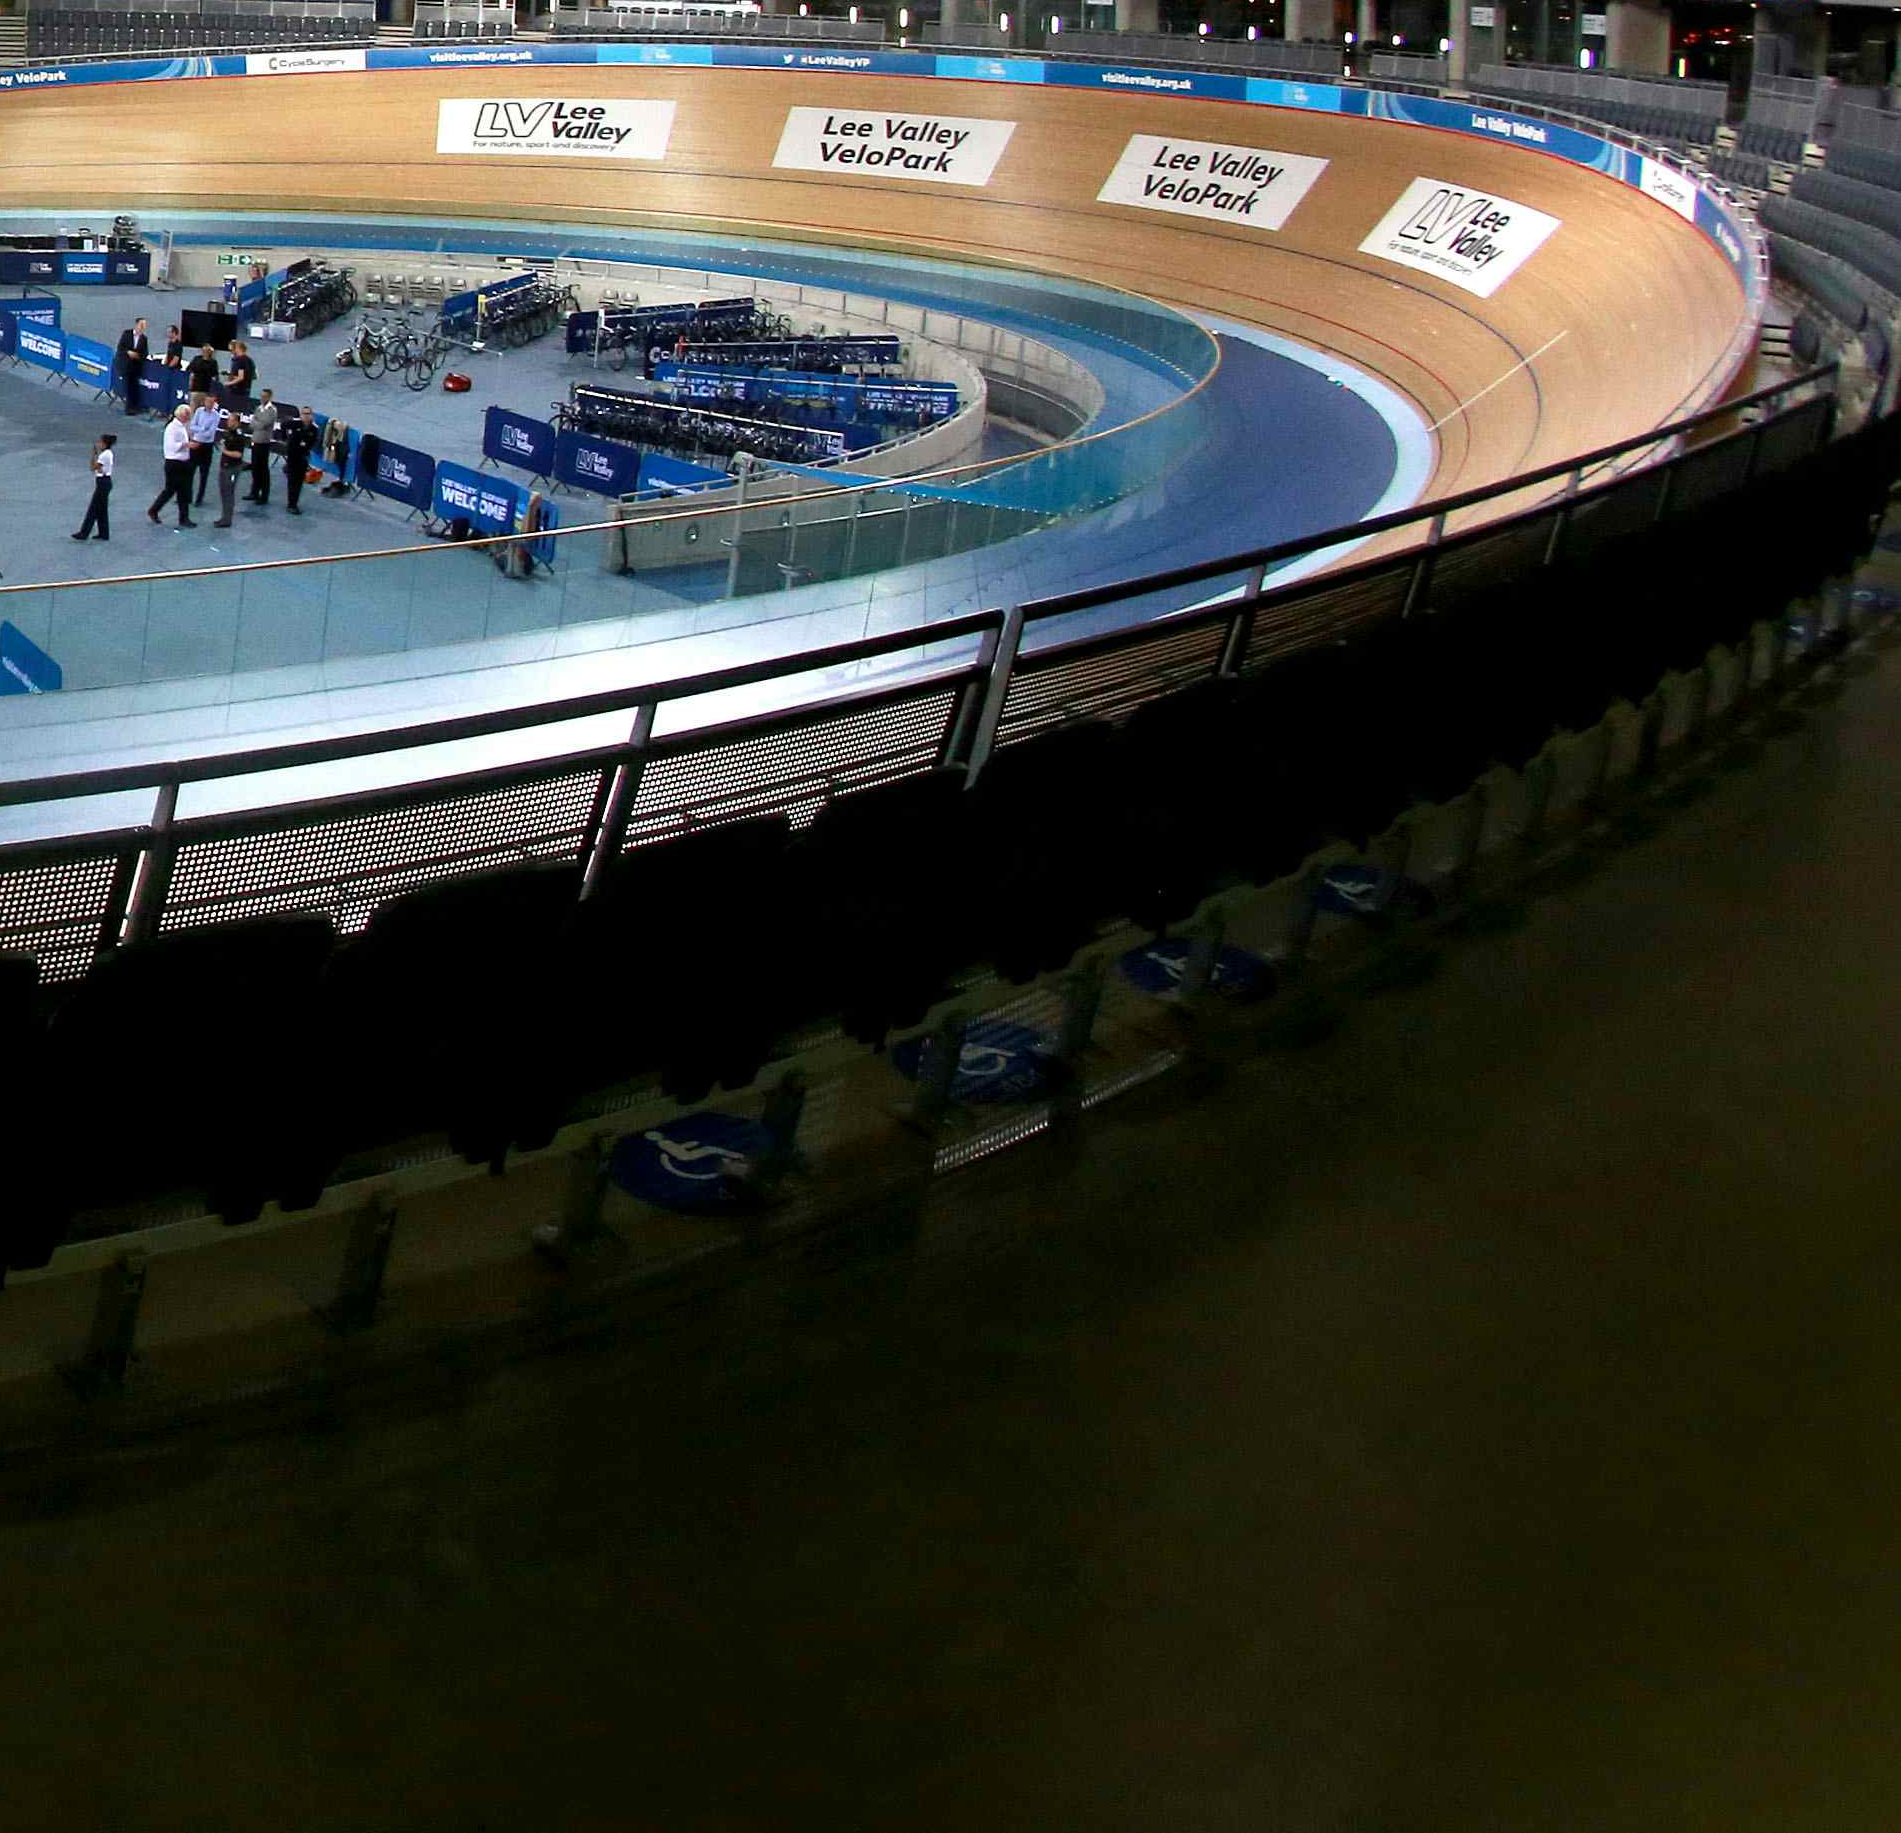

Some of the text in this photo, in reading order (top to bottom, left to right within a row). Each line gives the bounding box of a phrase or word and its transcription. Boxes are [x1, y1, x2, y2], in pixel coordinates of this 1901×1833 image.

[15, 70, 66, 84] VeloPark
[554, 103, 606, 119] Lee
[551, 121, 632, 144] Valley
[553, 141, 570, 149] and
[823, 116, 969, 150] Lee Valley
[820, 142, 953, 172] VeloPark
[1153, 146, 1284, 189] Lee Valley
[1144, 174, 1259, 214] VeloPark
[1471, 201, 1510, 232] Lee
[1447, 225, 1504, 268] Valley
[20, 336, 61, 360] WELCOME
[442, 486, 507, 521] WELCOME
